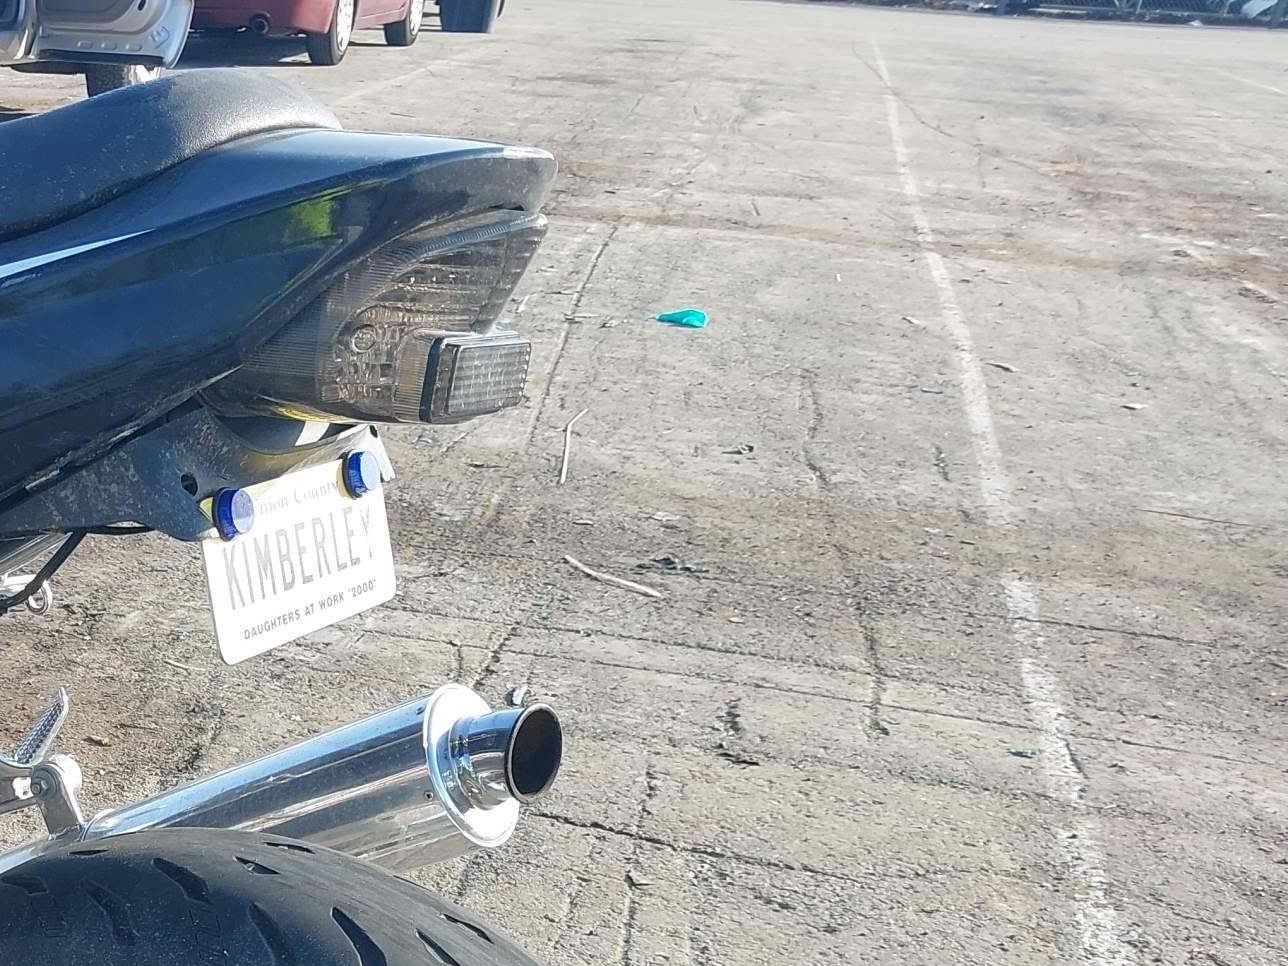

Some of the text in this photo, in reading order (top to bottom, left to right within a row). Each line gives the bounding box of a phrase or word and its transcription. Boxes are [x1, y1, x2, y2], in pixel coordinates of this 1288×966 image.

[222, 503, 374, 611] KIMBERLEY
[243, 608, 302, 640] DAUGHTERS
[304, 602, 315, 617] AT
[318, 592, 345, 611] WORK
